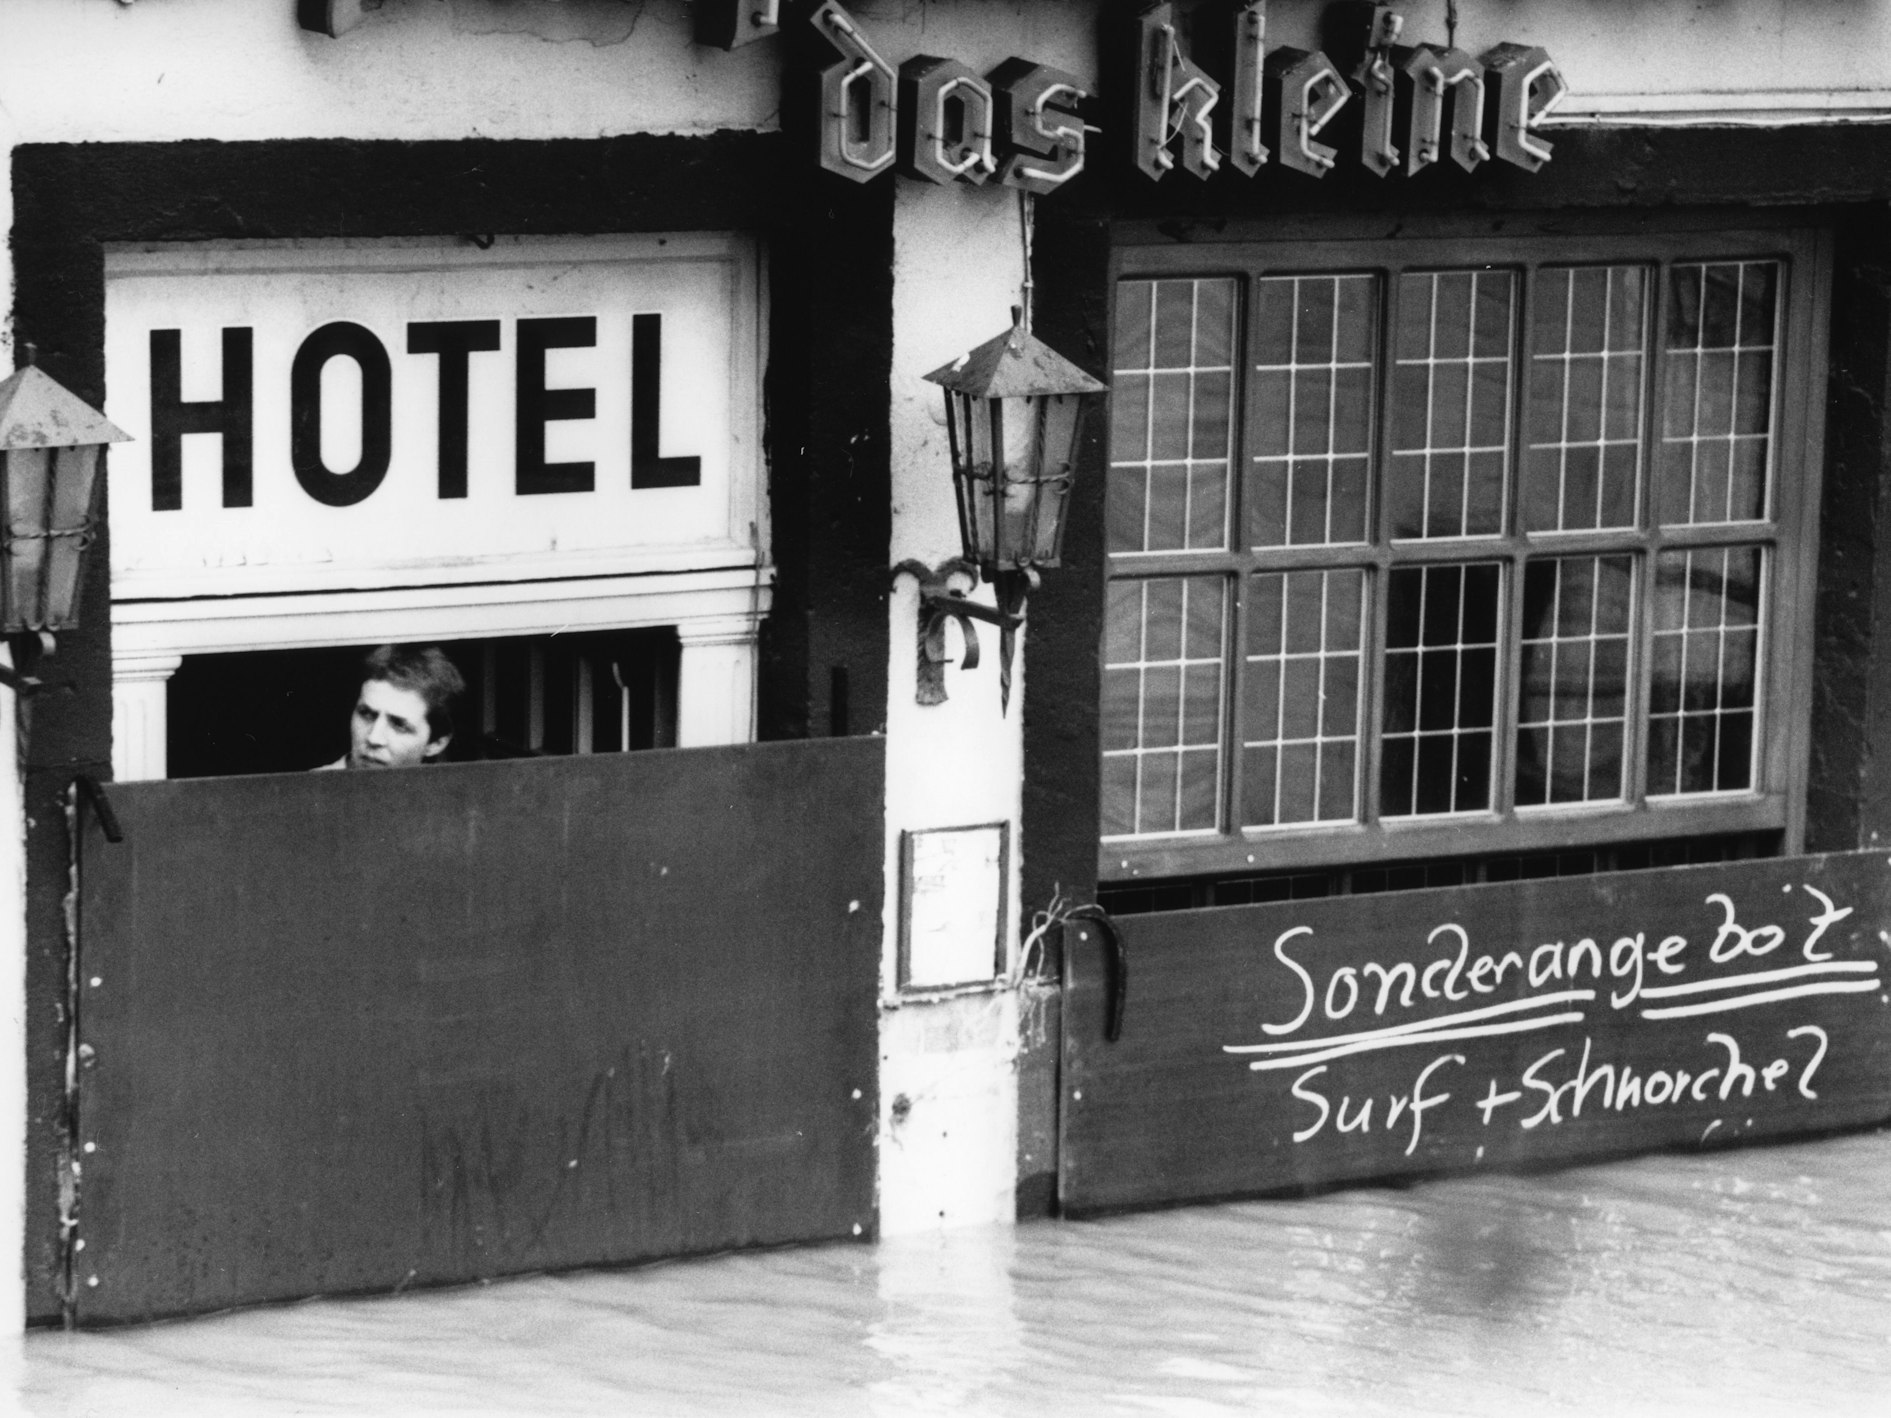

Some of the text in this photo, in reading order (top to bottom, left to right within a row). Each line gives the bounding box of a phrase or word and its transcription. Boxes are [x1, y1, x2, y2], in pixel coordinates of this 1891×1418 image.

[810, 1, 1569, 194] das kleine
[150, 313, 701, 512] HOTEL
[1262, 884, 1853, 1034] Sonderangebot
[1292, 1054, 1465, 1156] Surf
